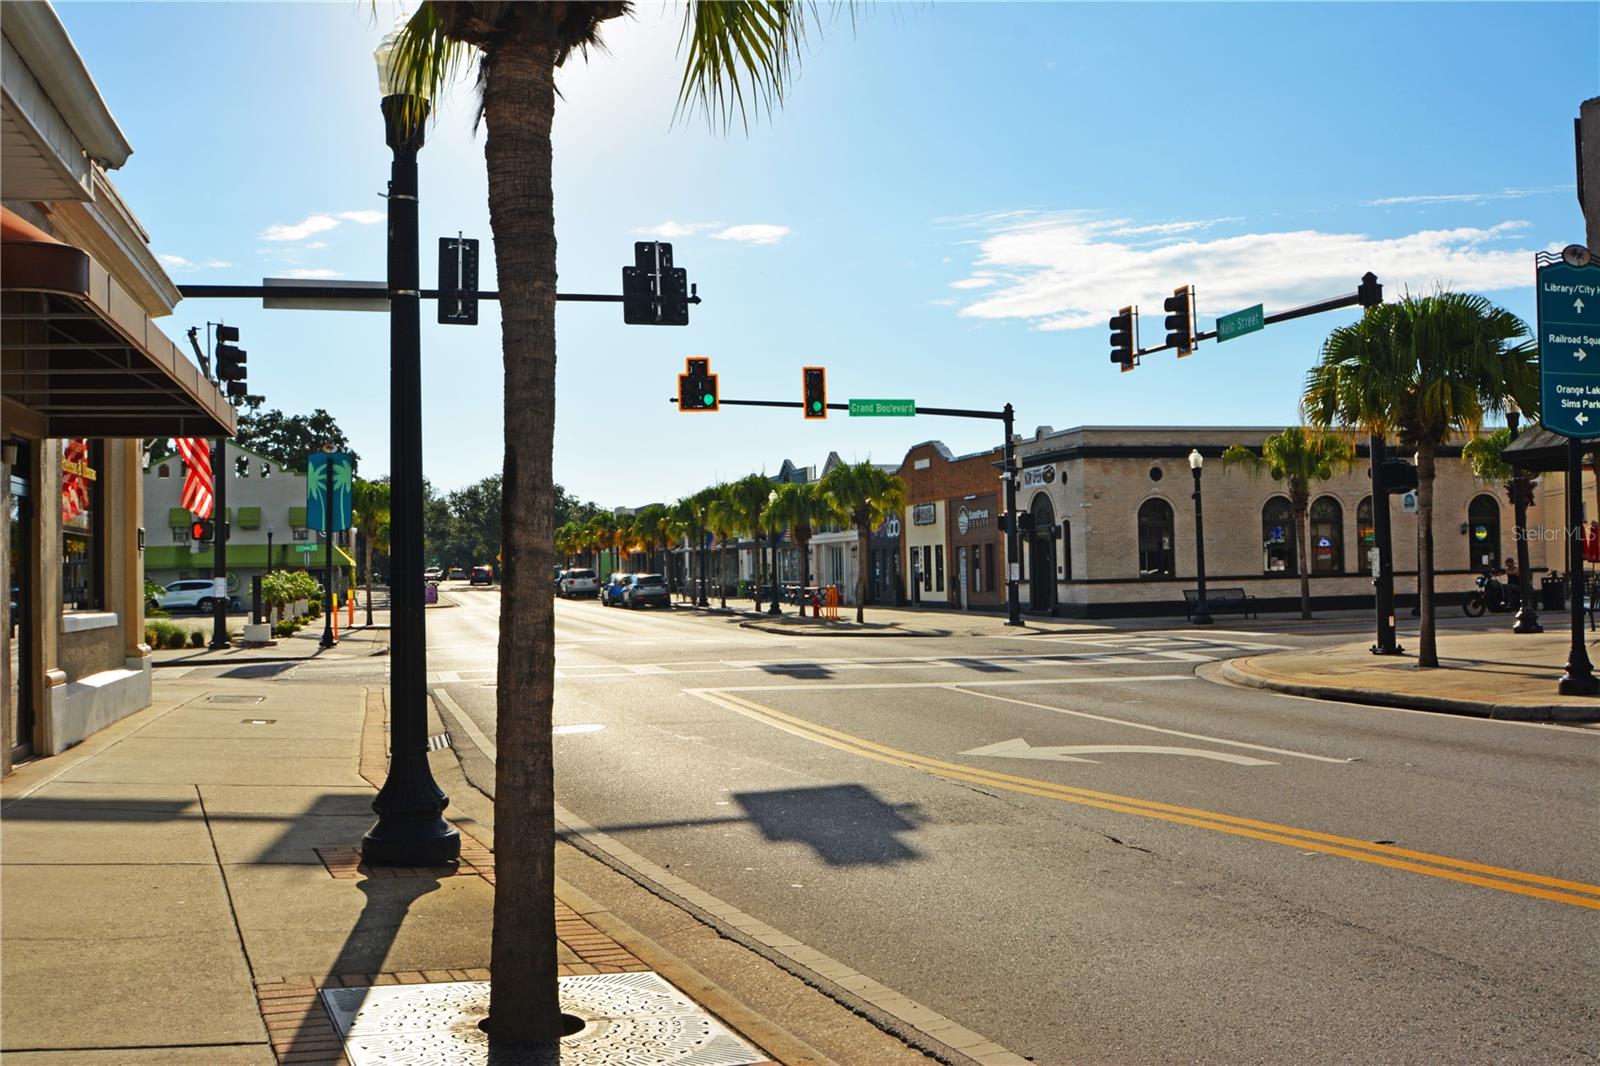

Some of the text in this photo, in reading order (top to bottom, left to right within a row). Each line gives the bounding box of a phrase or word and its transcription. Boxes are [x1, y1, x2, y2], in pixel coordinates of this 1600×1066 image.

[1544, 282, 1595, 296] Library/City
[1238, 313, 1259, 330] Street
[1548, 334, 1581, 344] Railroad
[1556, 384, 1584, 396] Orange
[851, 403, 913, 413] Grand Boulevard
[1561, 399, 1600, 408] Sims Park
